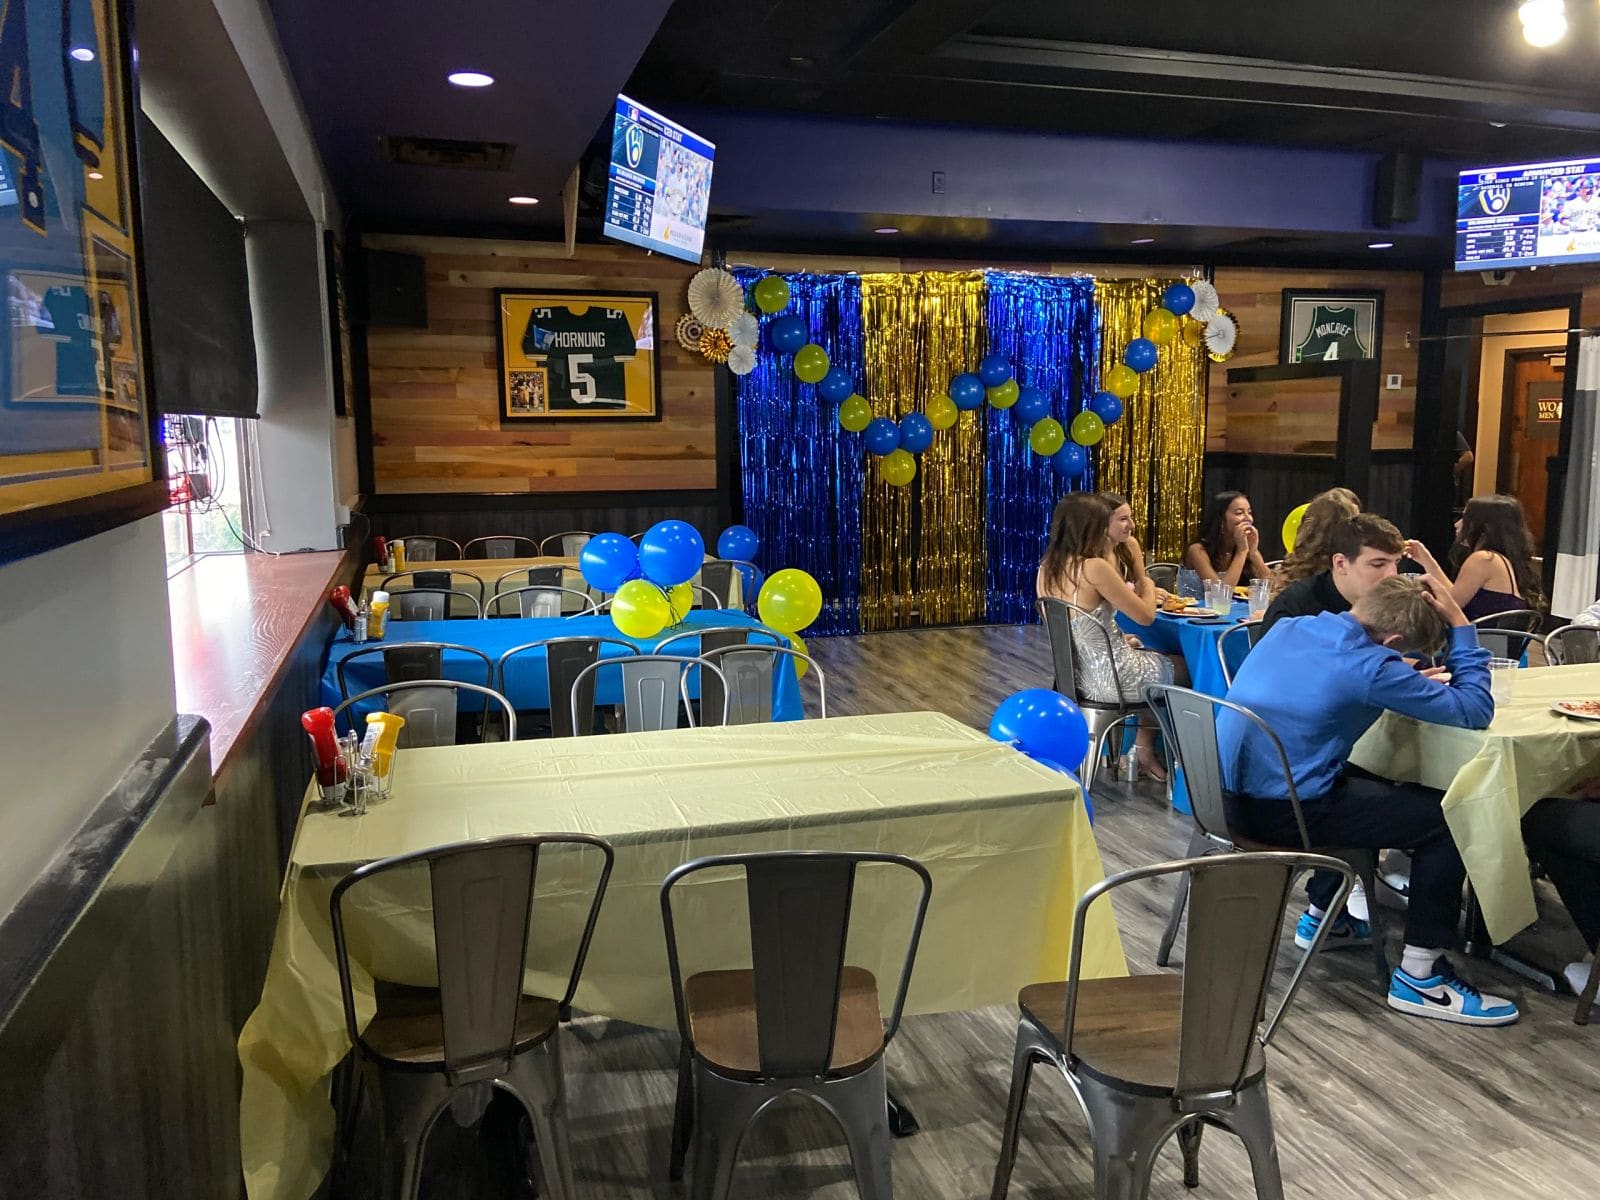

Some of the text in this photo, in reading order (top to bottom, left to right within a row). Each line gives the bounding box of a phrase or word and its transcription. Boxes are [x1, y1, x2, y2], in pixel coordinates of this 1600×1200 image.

[1315, 322, 1352, 338] MONCRIEF
[554, 332, 606, 348] HORNUNG
[1323, 341, 1340, 361] 4
[567, 353, 597, 404] 5
